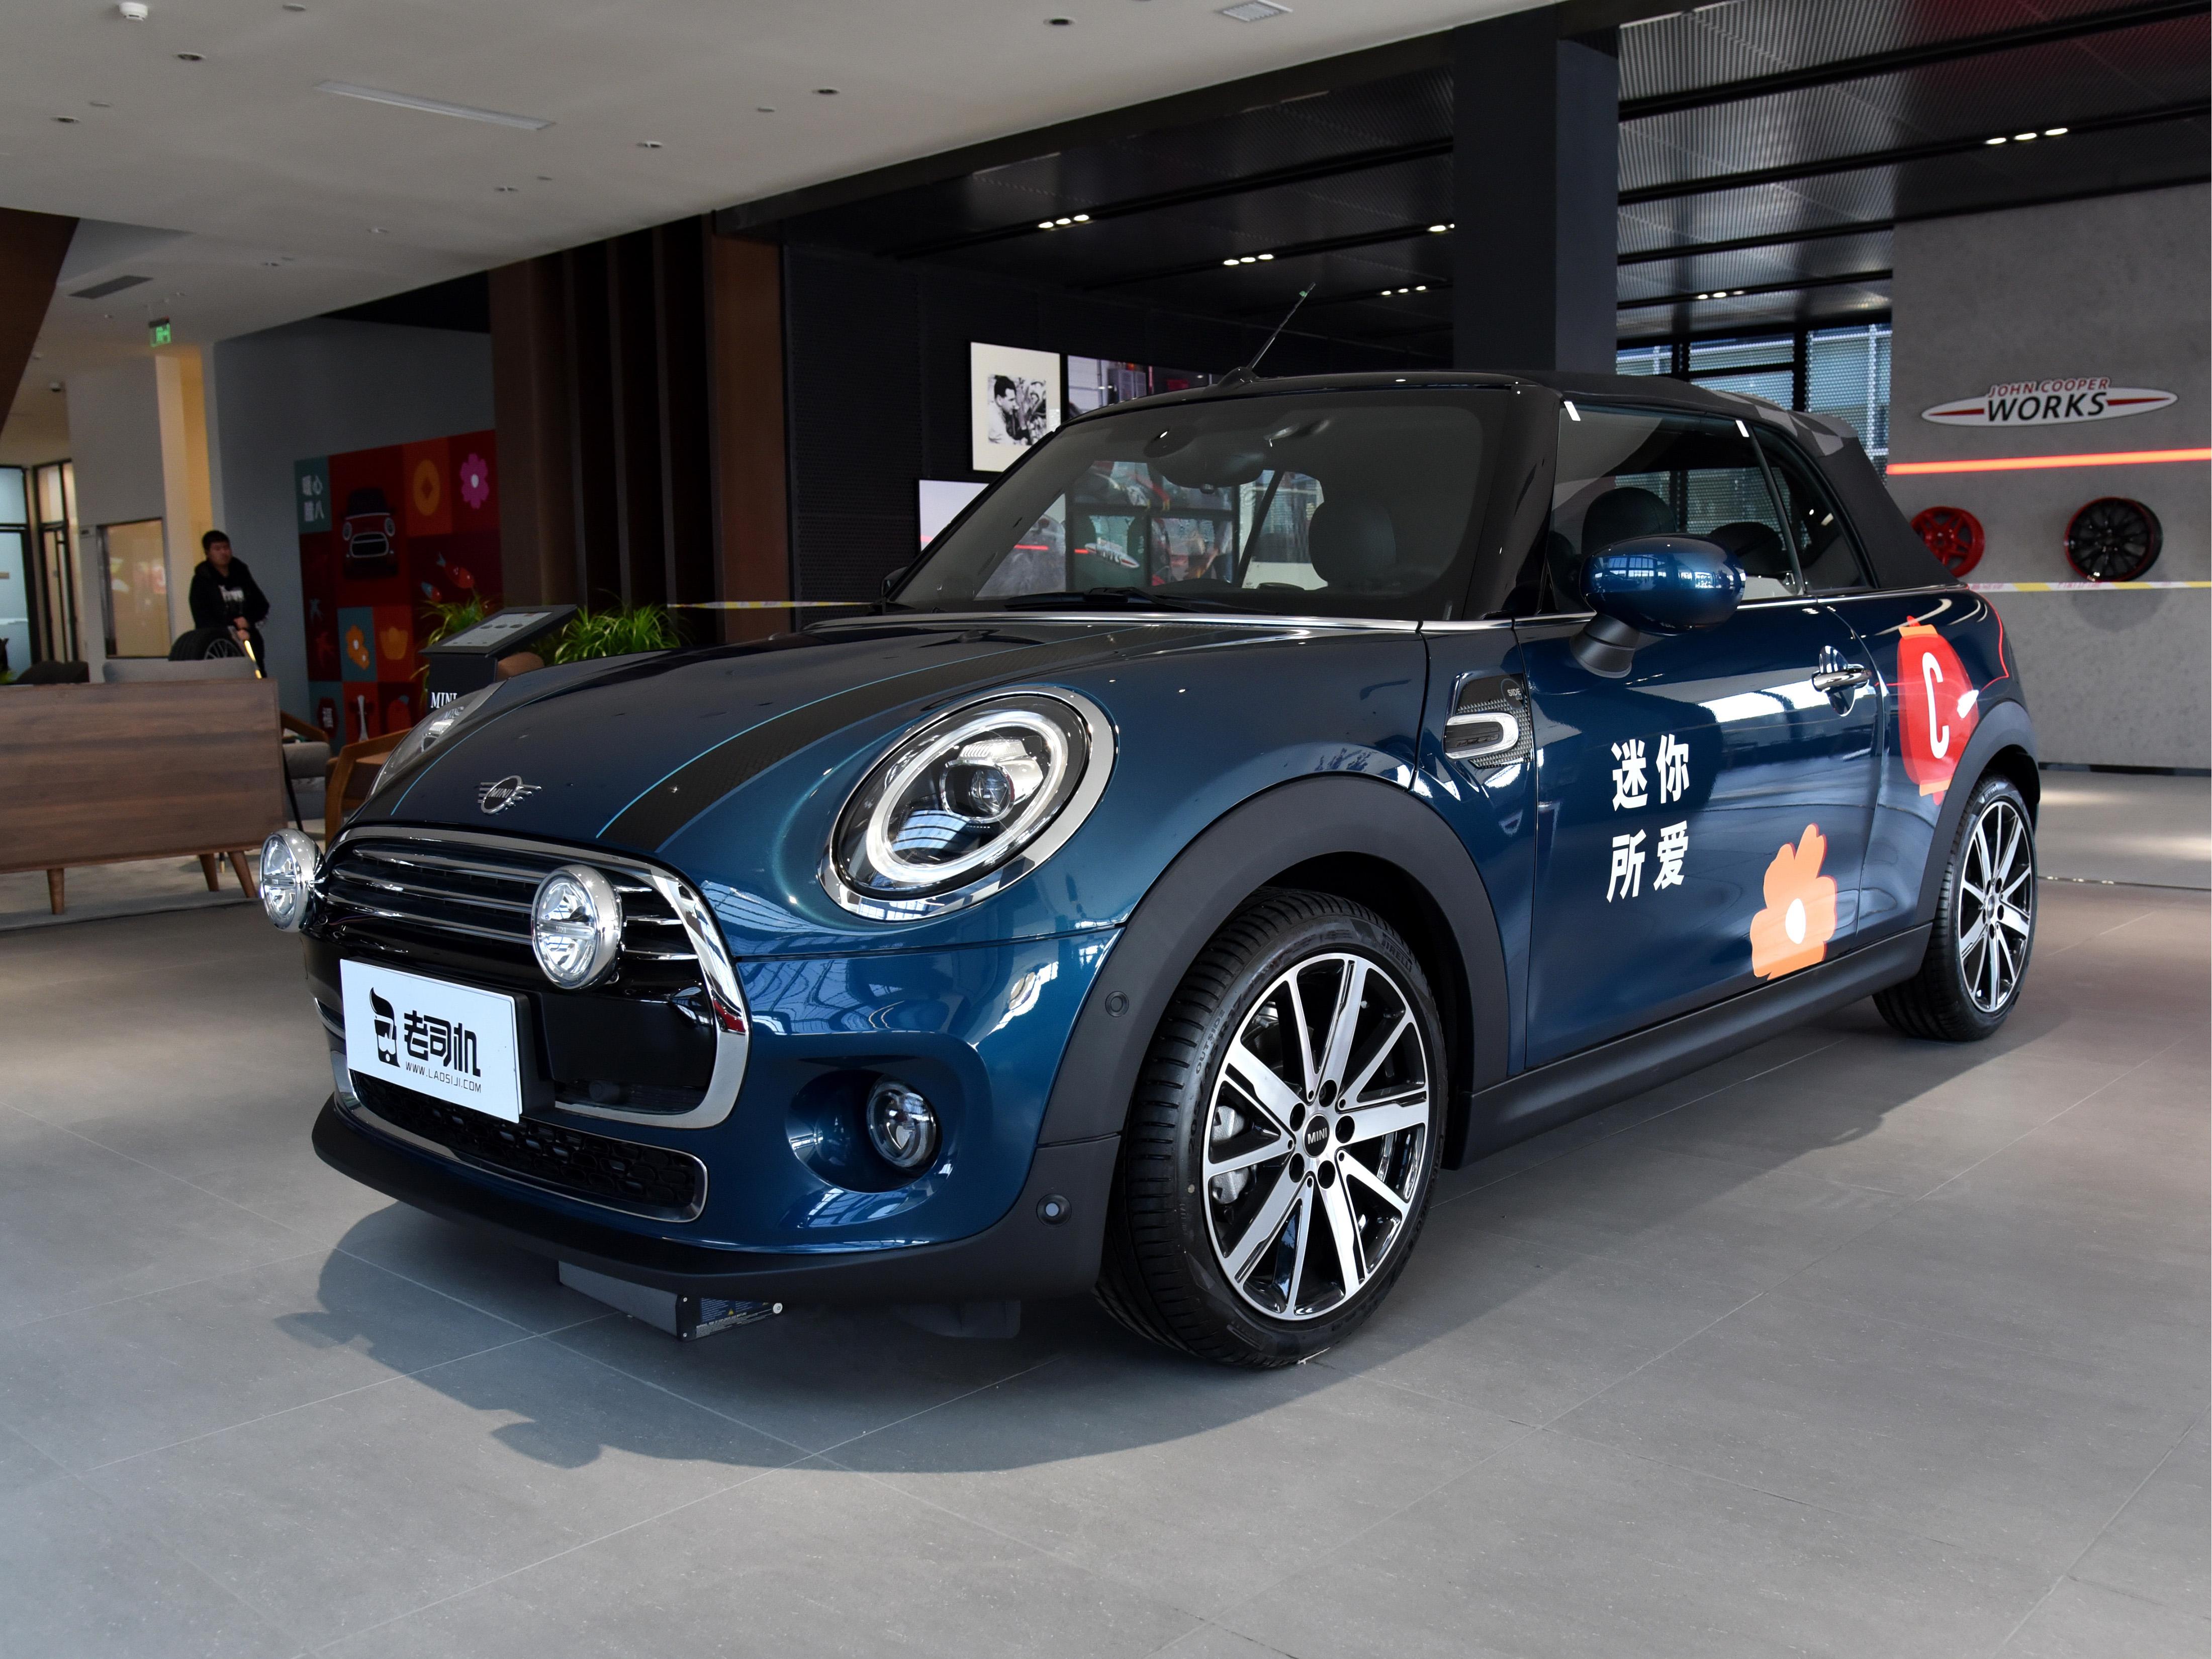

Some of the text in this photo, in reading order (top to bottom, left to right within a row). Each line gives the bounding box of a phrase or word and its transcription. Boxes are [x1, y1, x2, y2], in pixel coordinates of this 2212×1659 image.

[1988, 379, 2108, 398] JOHN COOPER
[1988, 392, 2107, 422] WORKS
[1507, 688, 1522, 697] SIDE
[1611, 733, 1690, 812] 迷你
[488, 788, 513, 798] MINI
[1606, 820, 1689, 903] 所爱
[404, 1009, 481, 1077] 老司机
[1195, 1009, 1225, 1074] OUTSIDE
[406, 1061, 481, 1093] WWW.LAOSIJI.COM
[1308, 1127, 1327, 1145] MINI
